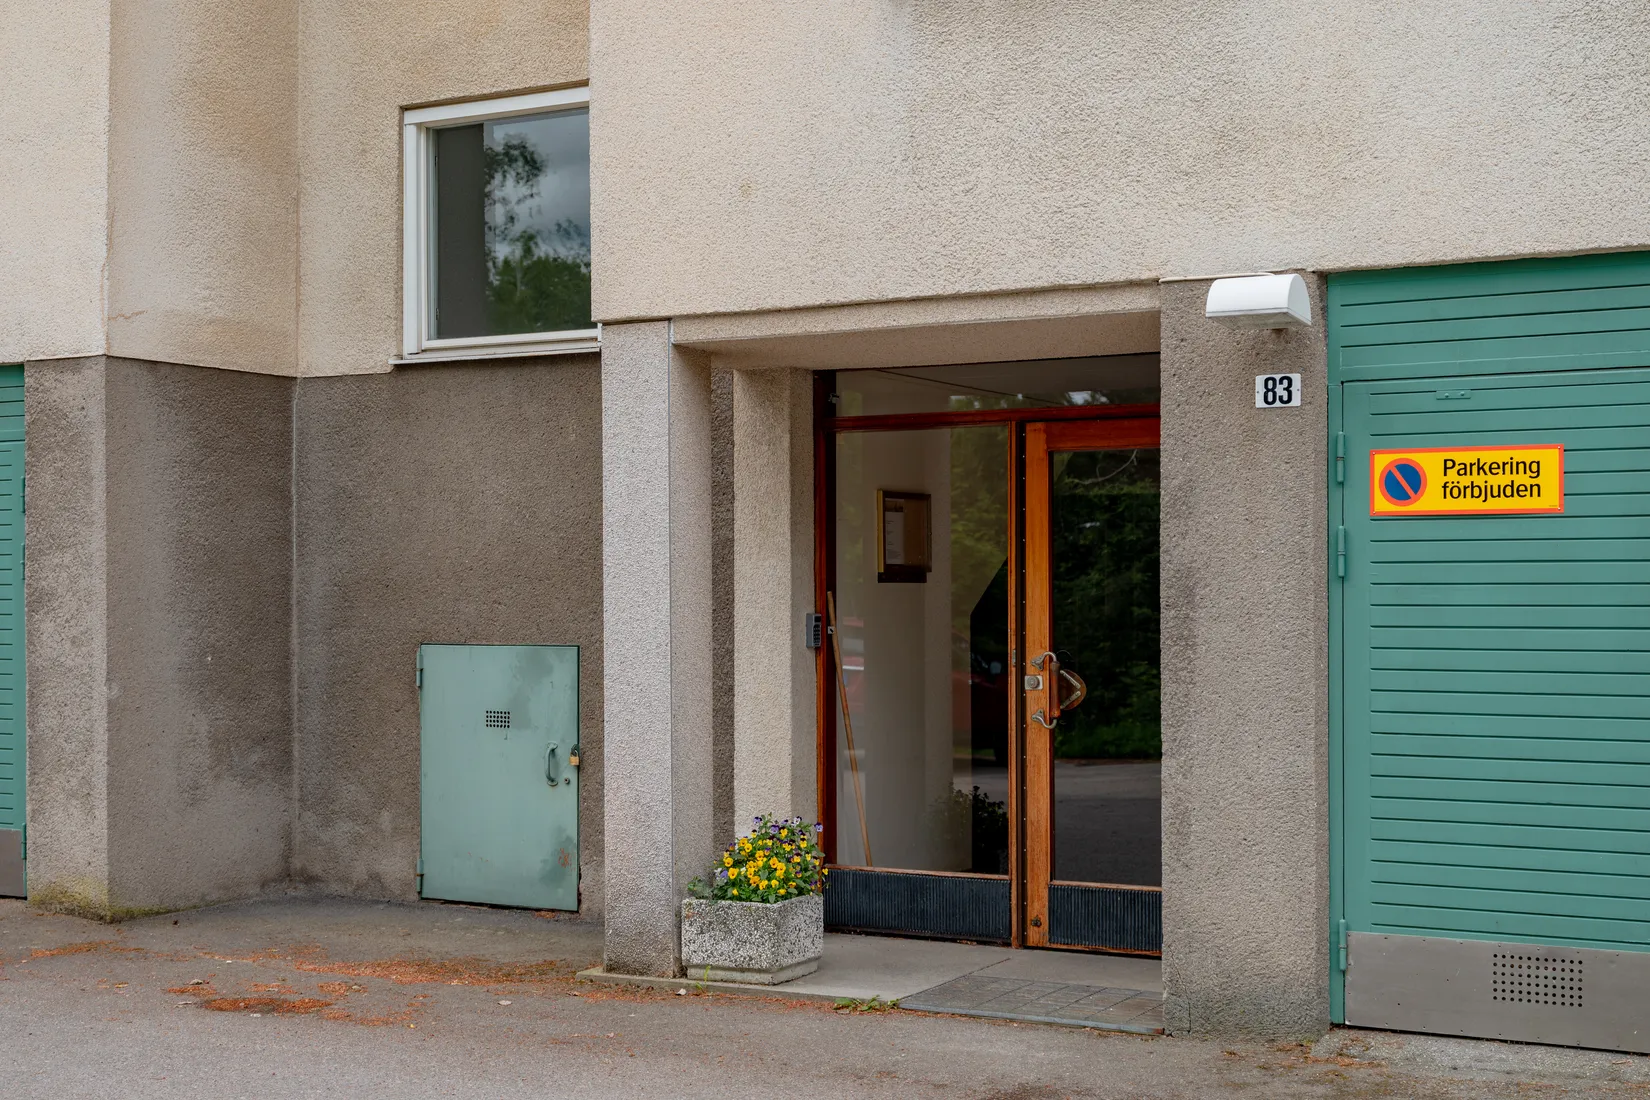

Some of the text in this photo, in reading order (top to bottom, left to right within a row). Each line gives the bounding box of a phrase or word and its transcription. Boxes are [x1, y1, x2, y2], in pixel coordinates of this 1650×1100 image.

[1263, 375, 1293, 406] 83
[1443, 457, 1541, 479] Parkering
[1442, 480, 1541, 503] förbjuden
